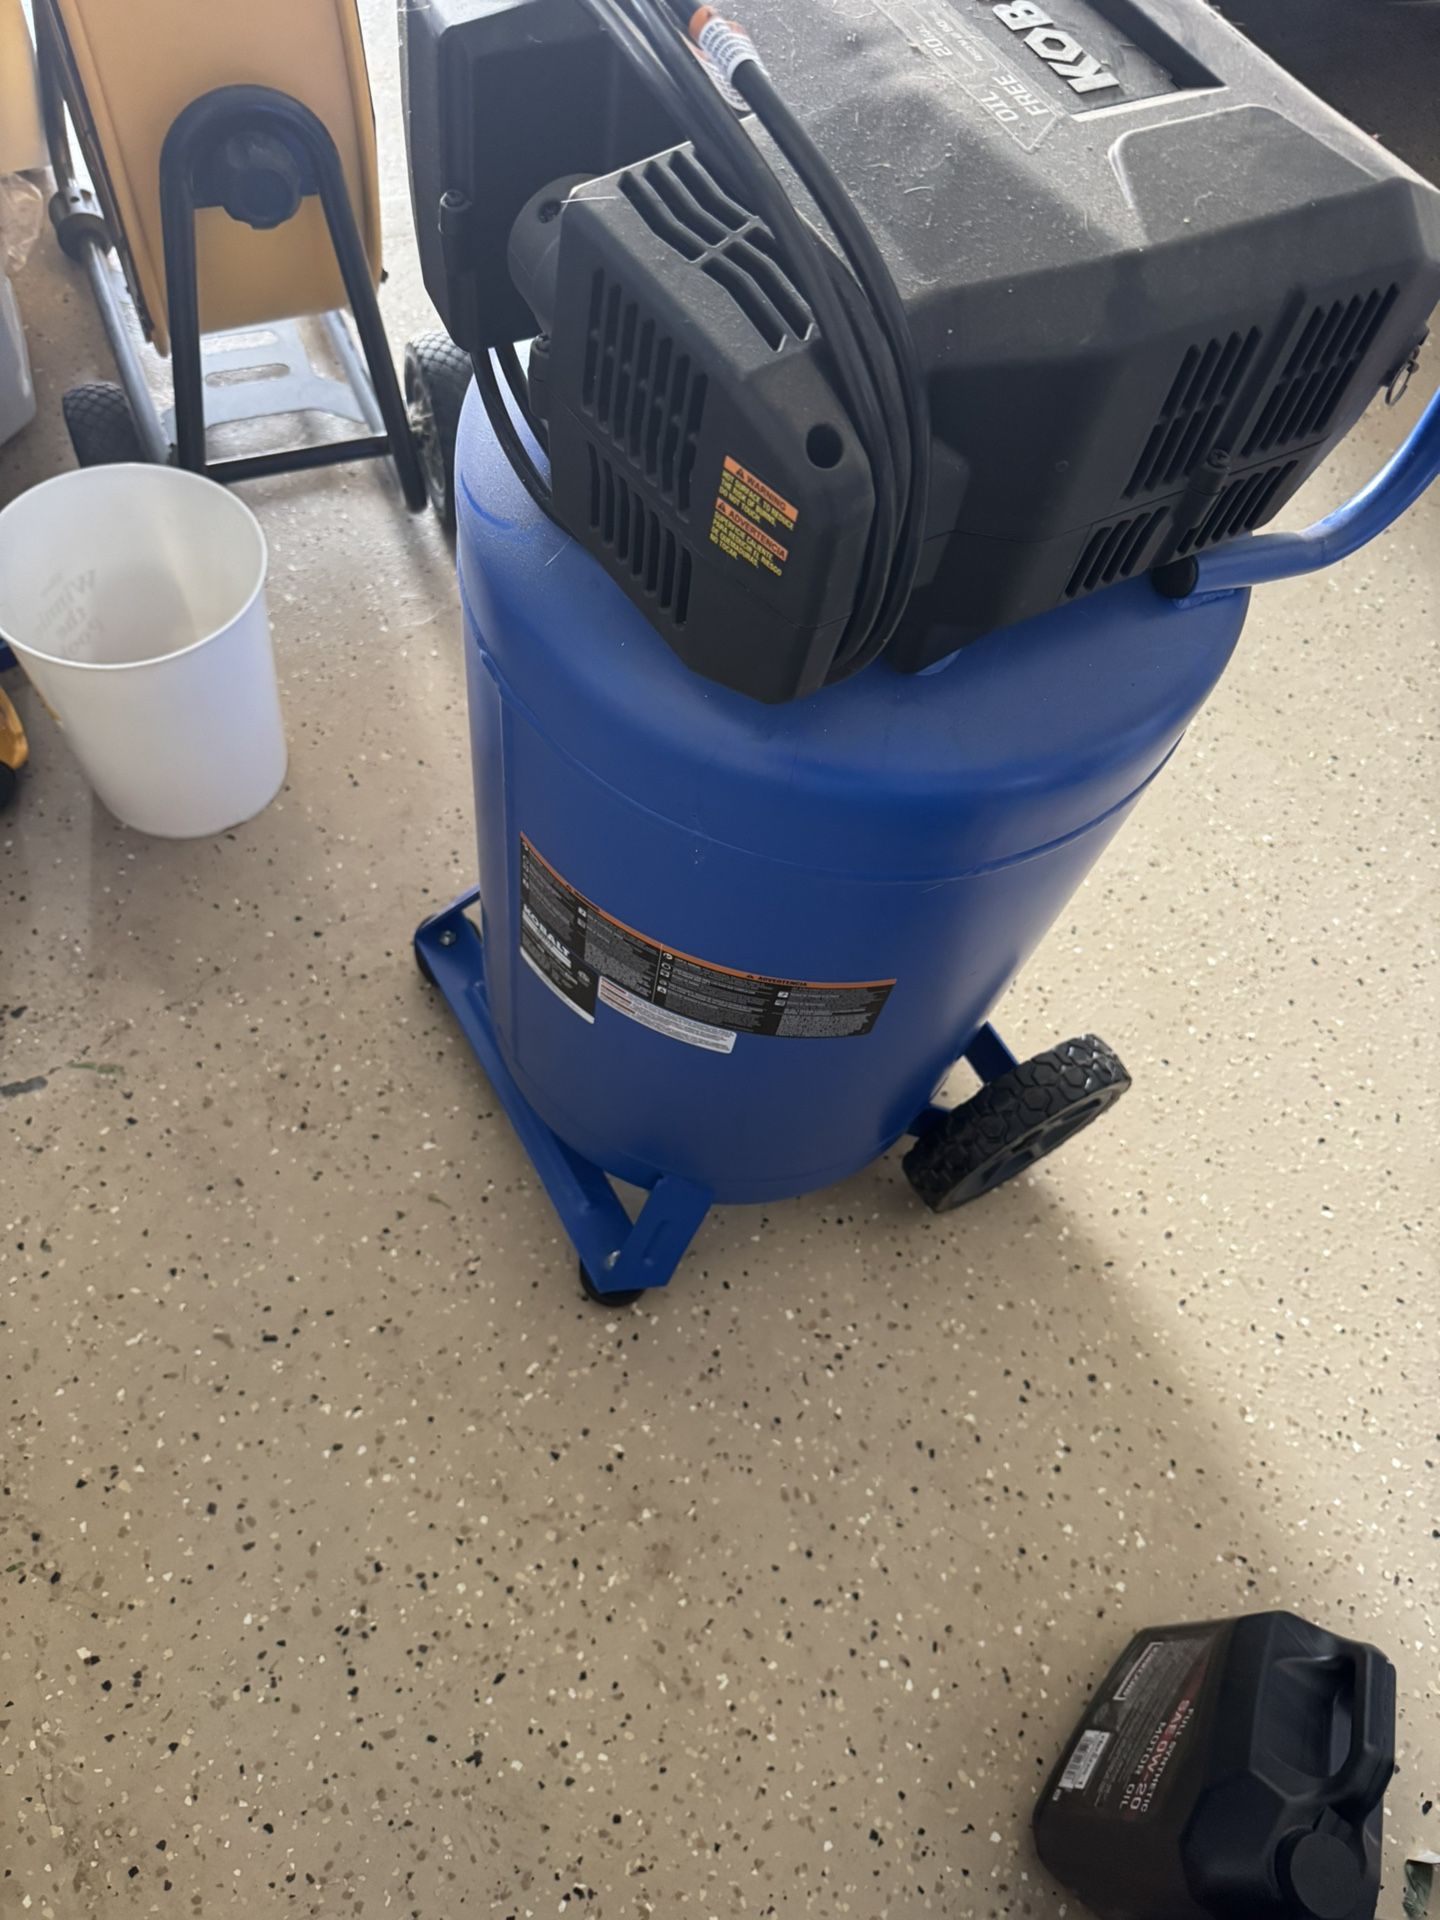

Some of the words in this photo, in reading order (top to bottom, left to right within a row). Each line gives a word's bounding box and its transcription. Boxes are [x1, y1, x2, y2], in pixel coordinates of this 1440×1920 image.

[980, 92, 1019, 122] OIL
[992, 74, 1048, 117] FREE
[747, 475, 786, 511] WARNING
[729, 509, 785, 558] ADVERTENCIA
[523, 903, 571, 956] KOBALT
[1165, 1700, 1190, 1736] SAE
[1175, 1707, 1194, 1737] FULL
[1135, 1722, 1166, 1774] MOTOR
[1119, 1784, 1135, 1809] OIL
[1130, 1740, 1168, 1810] 0W-20
[1141, 1741, 1176, 1812] SYNTHETIC
